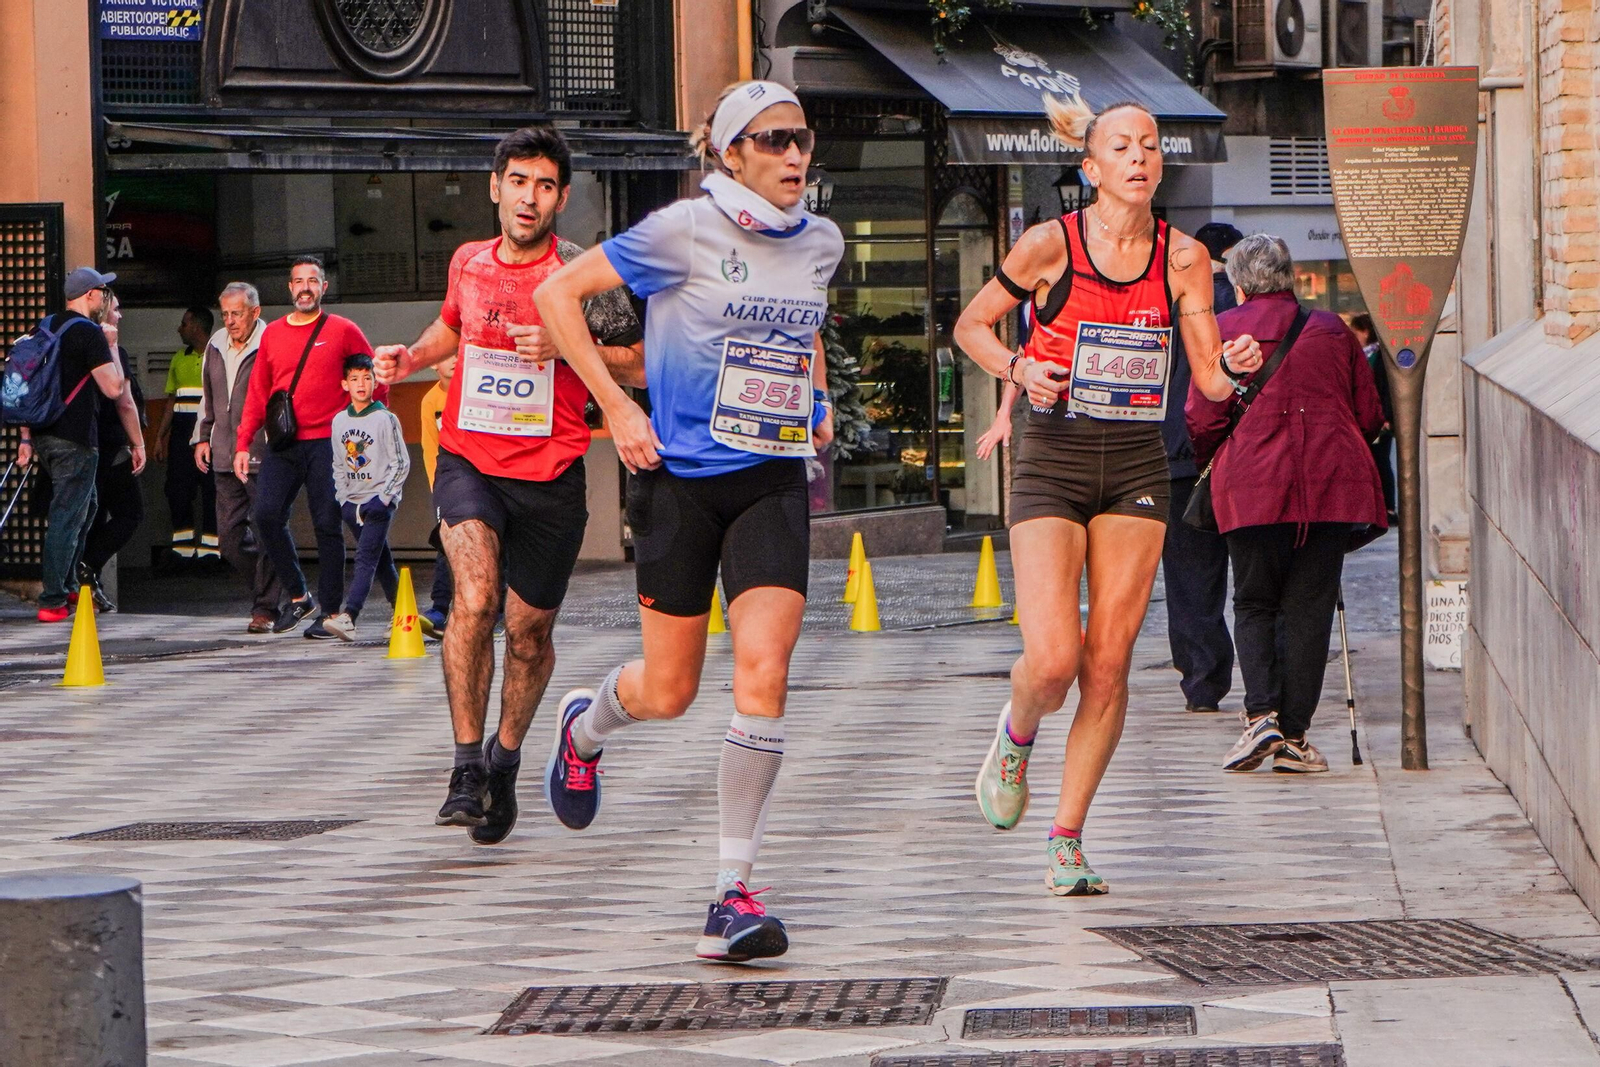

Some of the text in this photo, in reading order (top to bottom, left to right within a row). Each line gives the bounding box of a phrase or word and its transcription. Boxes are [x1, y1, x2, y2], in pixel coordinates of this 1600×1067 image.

[110, 25, 190, 37] PUBLICO/PUBLIC
[742, 295, 766, 303] CLUB
[781, 298, 823, 308] ATLETISMO
[1100, 337, 1143, 347] UNIVERSIDAD
[483, 353, 532, 364] CARRE
[483, 360, 518, 370] UNIVERSIDAD
[1085, 353, 1160, 380] 1461
[476, 375, 535, 398] 260
[738, 378, 802, 410] 352
[738, 412, 763, 422] TATIANA
[763, 416, 780, 425] VACAS
[346, 472, 373, 480] CHOOL
[1431, 597, 1455, 607] UNA
[1455, 611, 1466, 622] SE
[1429, 622, 1466, 633] AYUDA
